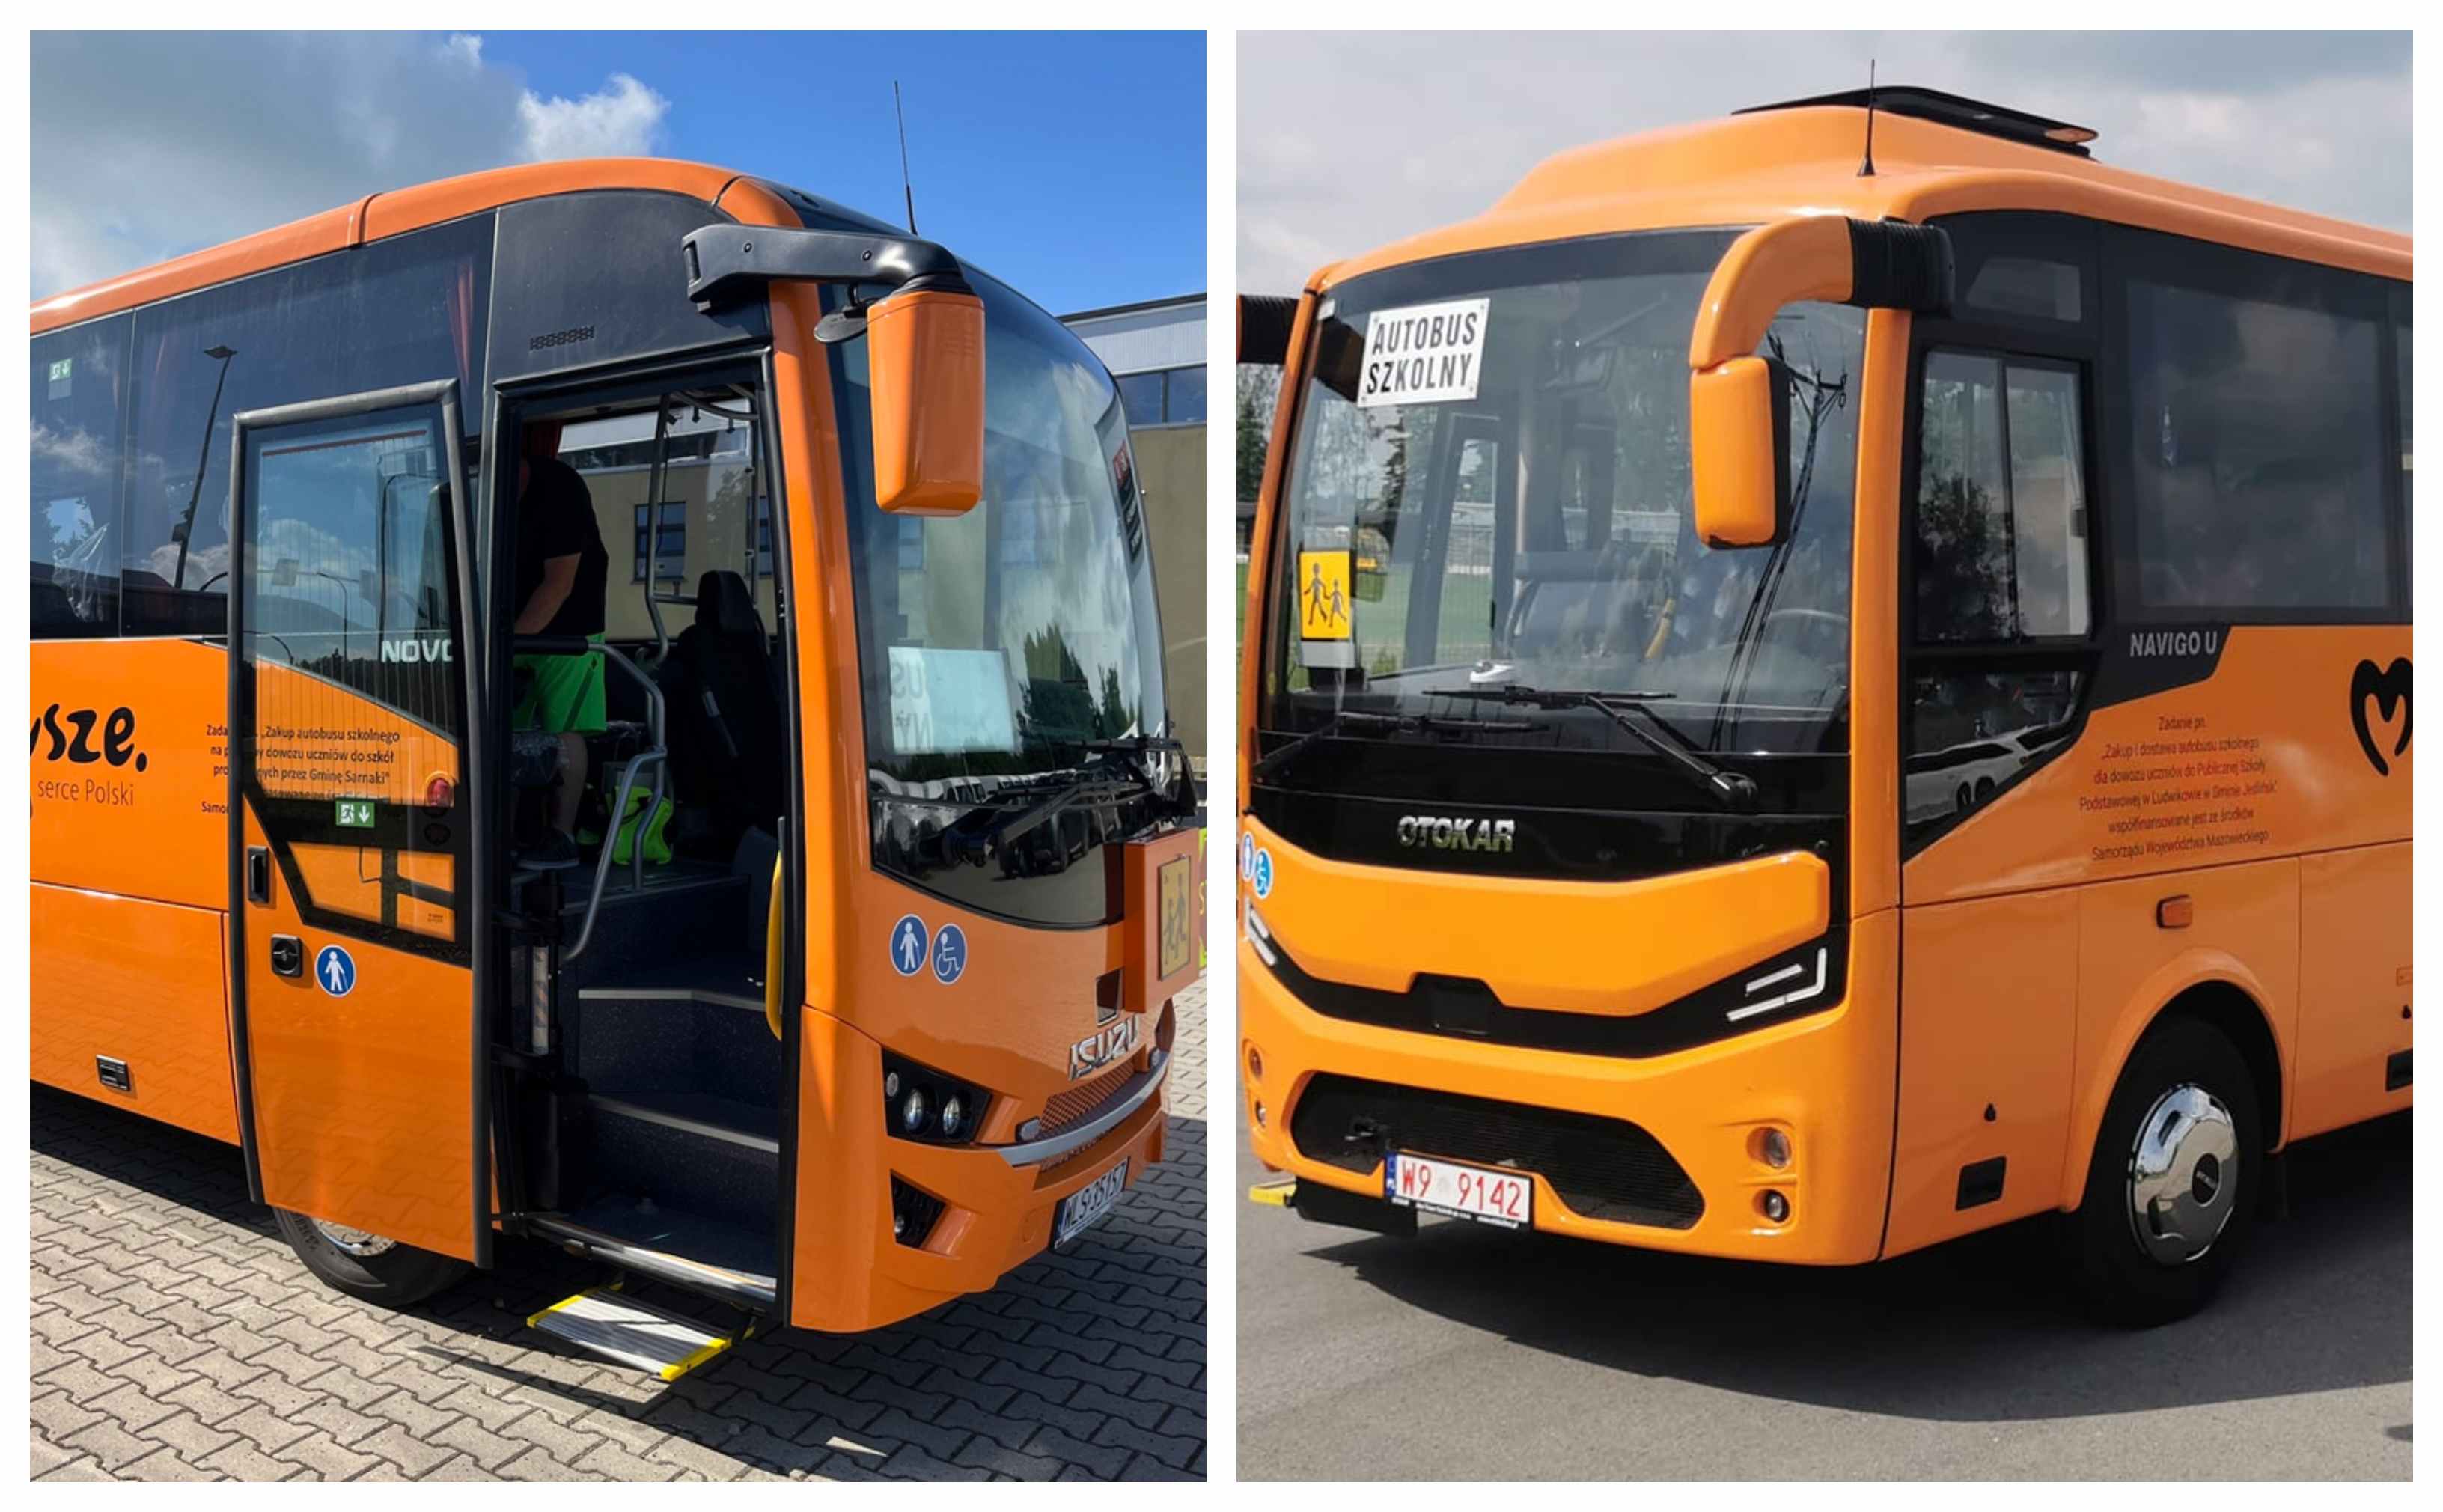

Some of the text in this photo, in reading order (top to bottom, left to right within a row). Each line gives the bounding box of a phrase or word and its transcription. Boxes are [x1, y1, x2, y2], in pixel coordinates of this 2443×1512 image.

[1372, 312, 1478, 356] AUTOBUS
[1367, 353, 1473, 394] SZKOLNY
[2130, 631, 2218, 657] NAVIGO U
[30, 704, 148, 772] sze.
[296, 728, 344, 741] autobusu
[347, 729, 400, 745] szkolnego
[266, 747, 304, 760] dowozu
[306, 749, 348, 761] uczniów
[350, 751, 365, 762] do
[367, 752, 394, 764] szkół
[37, 778, 134, 806] serce Polski
[281, 769, 307, 780] przez
[309, 769, 342, 784] Gminę
[1397, 815, 1515, 852] OTOKAR
[1068, 1013, 1141, 1081] ISUZU
[1401, 1160, 1432, 1198] W9
[1457, 1171, 1522, 1218] 9142
